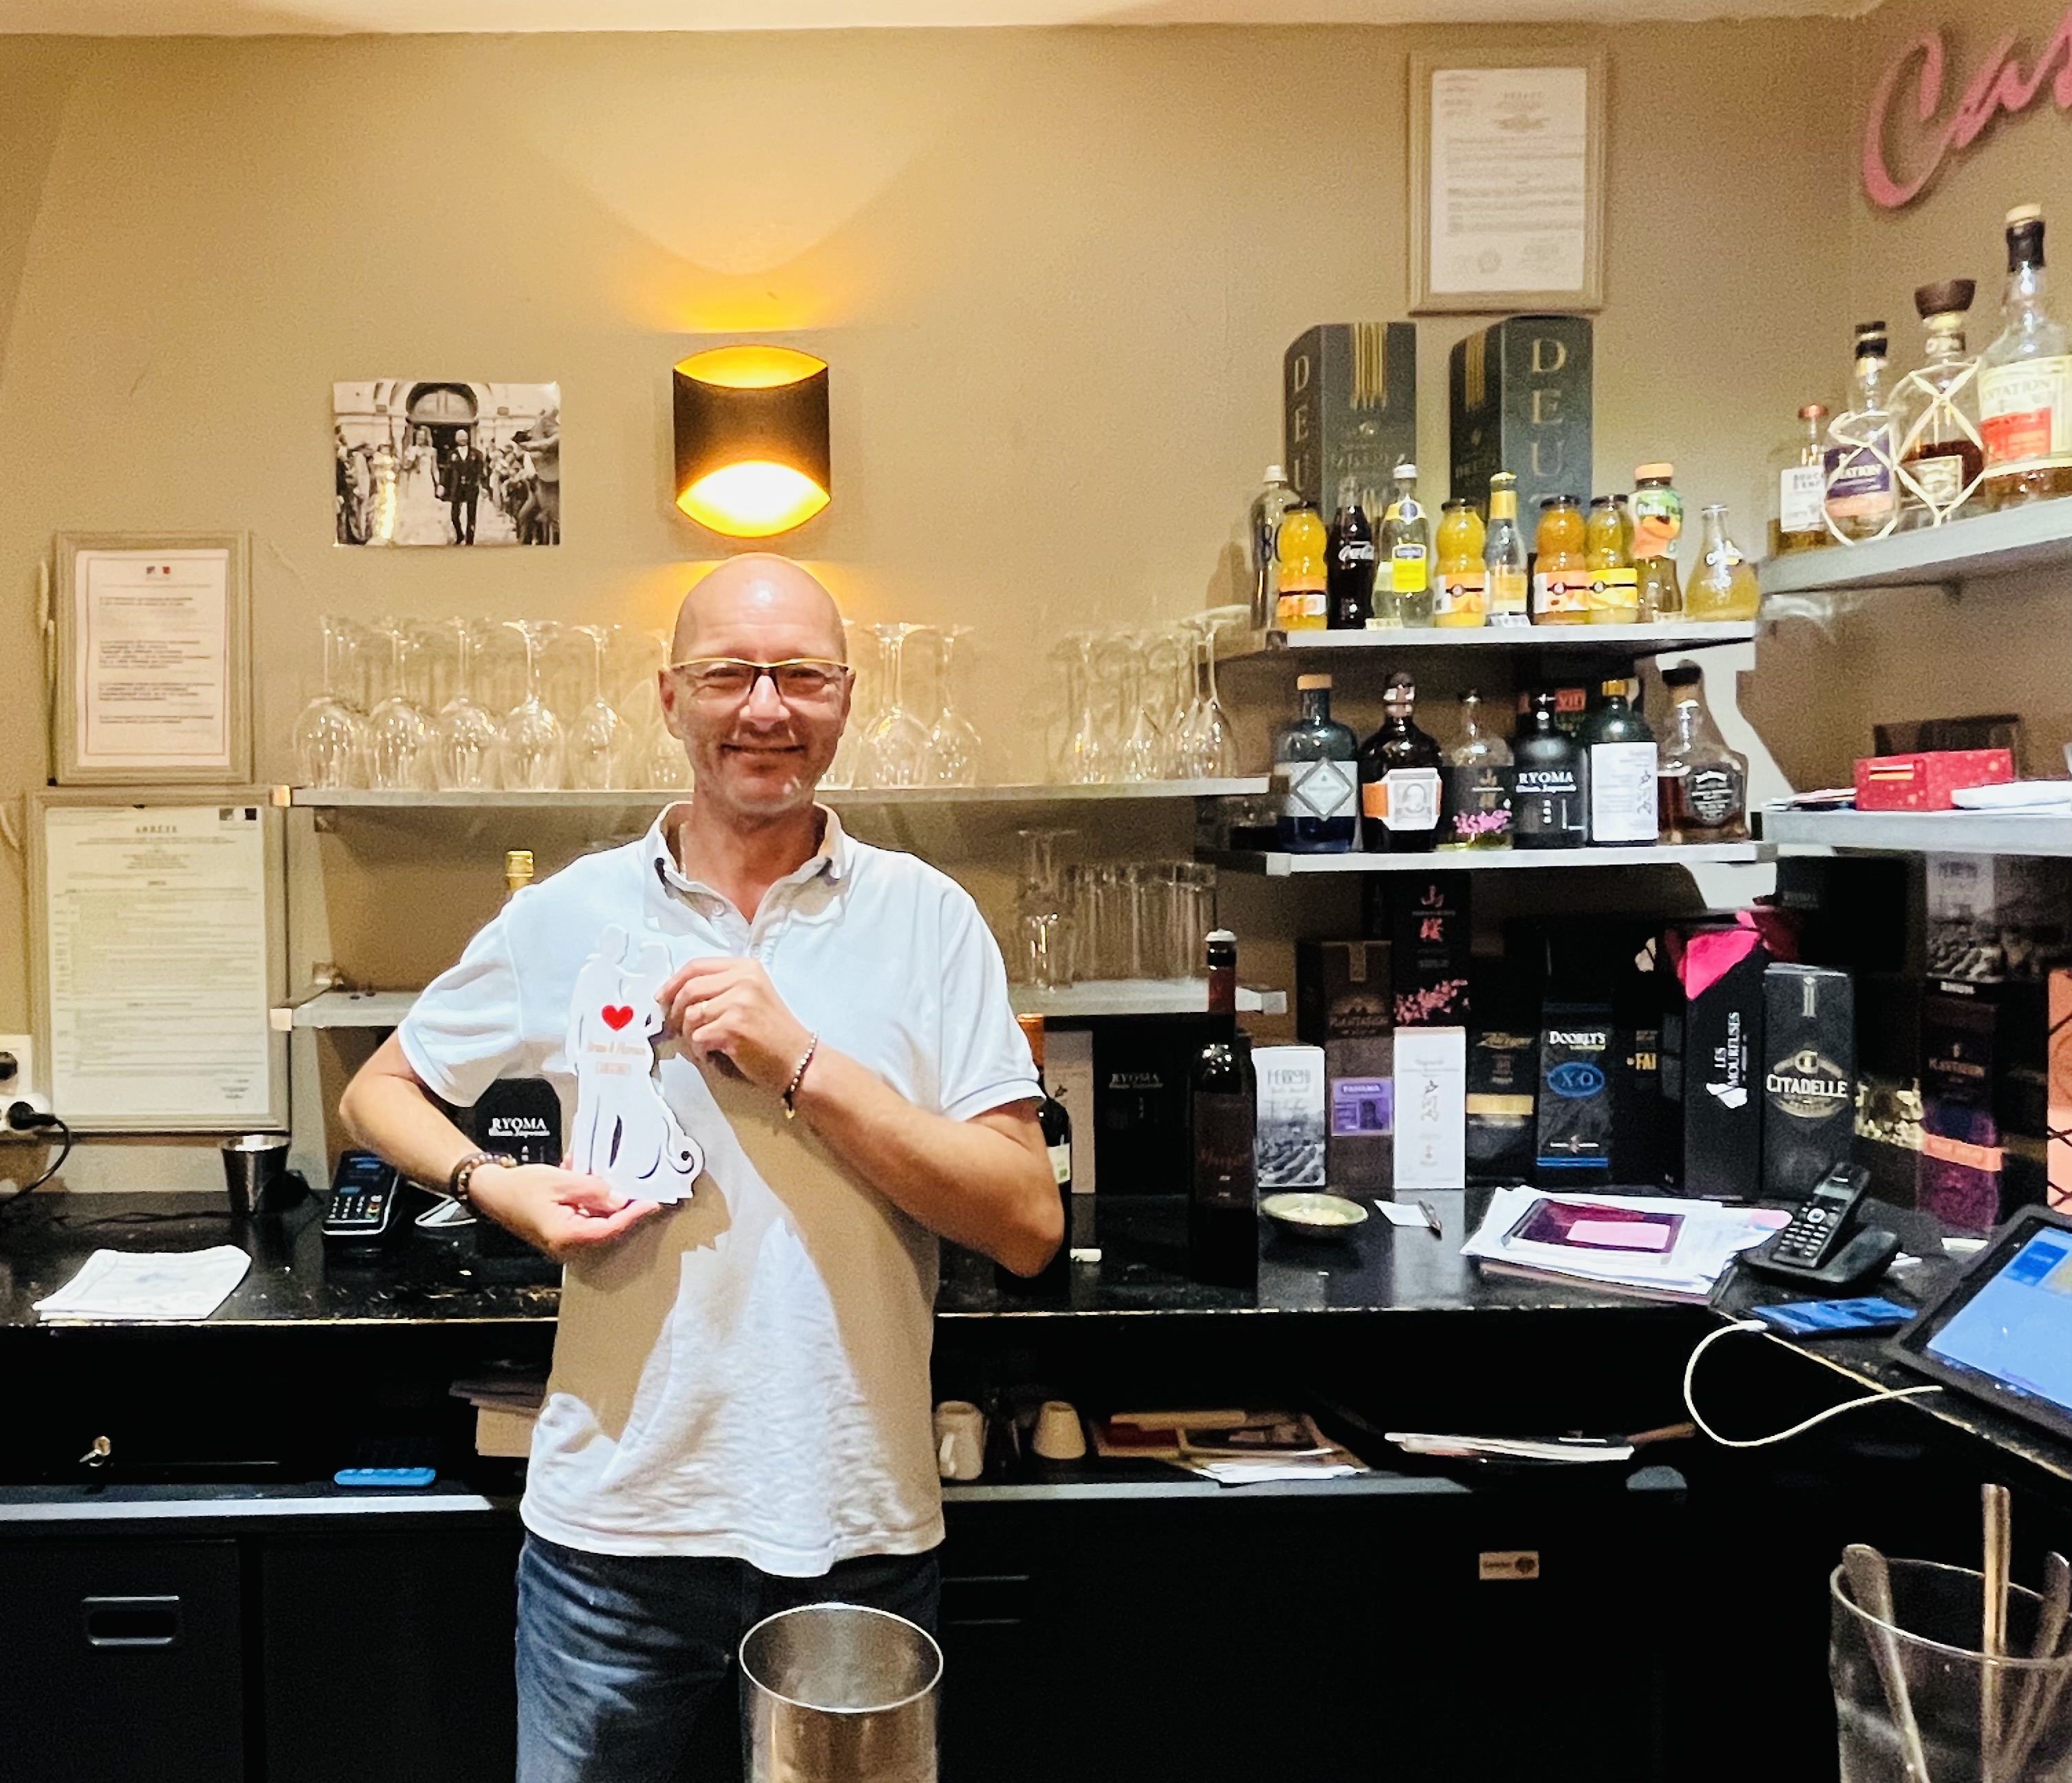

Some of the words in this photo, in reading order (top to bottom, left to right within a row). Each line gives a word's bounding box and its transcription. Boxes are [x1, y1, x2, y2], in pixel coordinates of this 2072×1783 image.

[1518, 771, 1574, 784] RYOMA
[1766, 1073, 1849, 1099] CITADELLE
[492, 1117, 548, 1130] RYOMA
